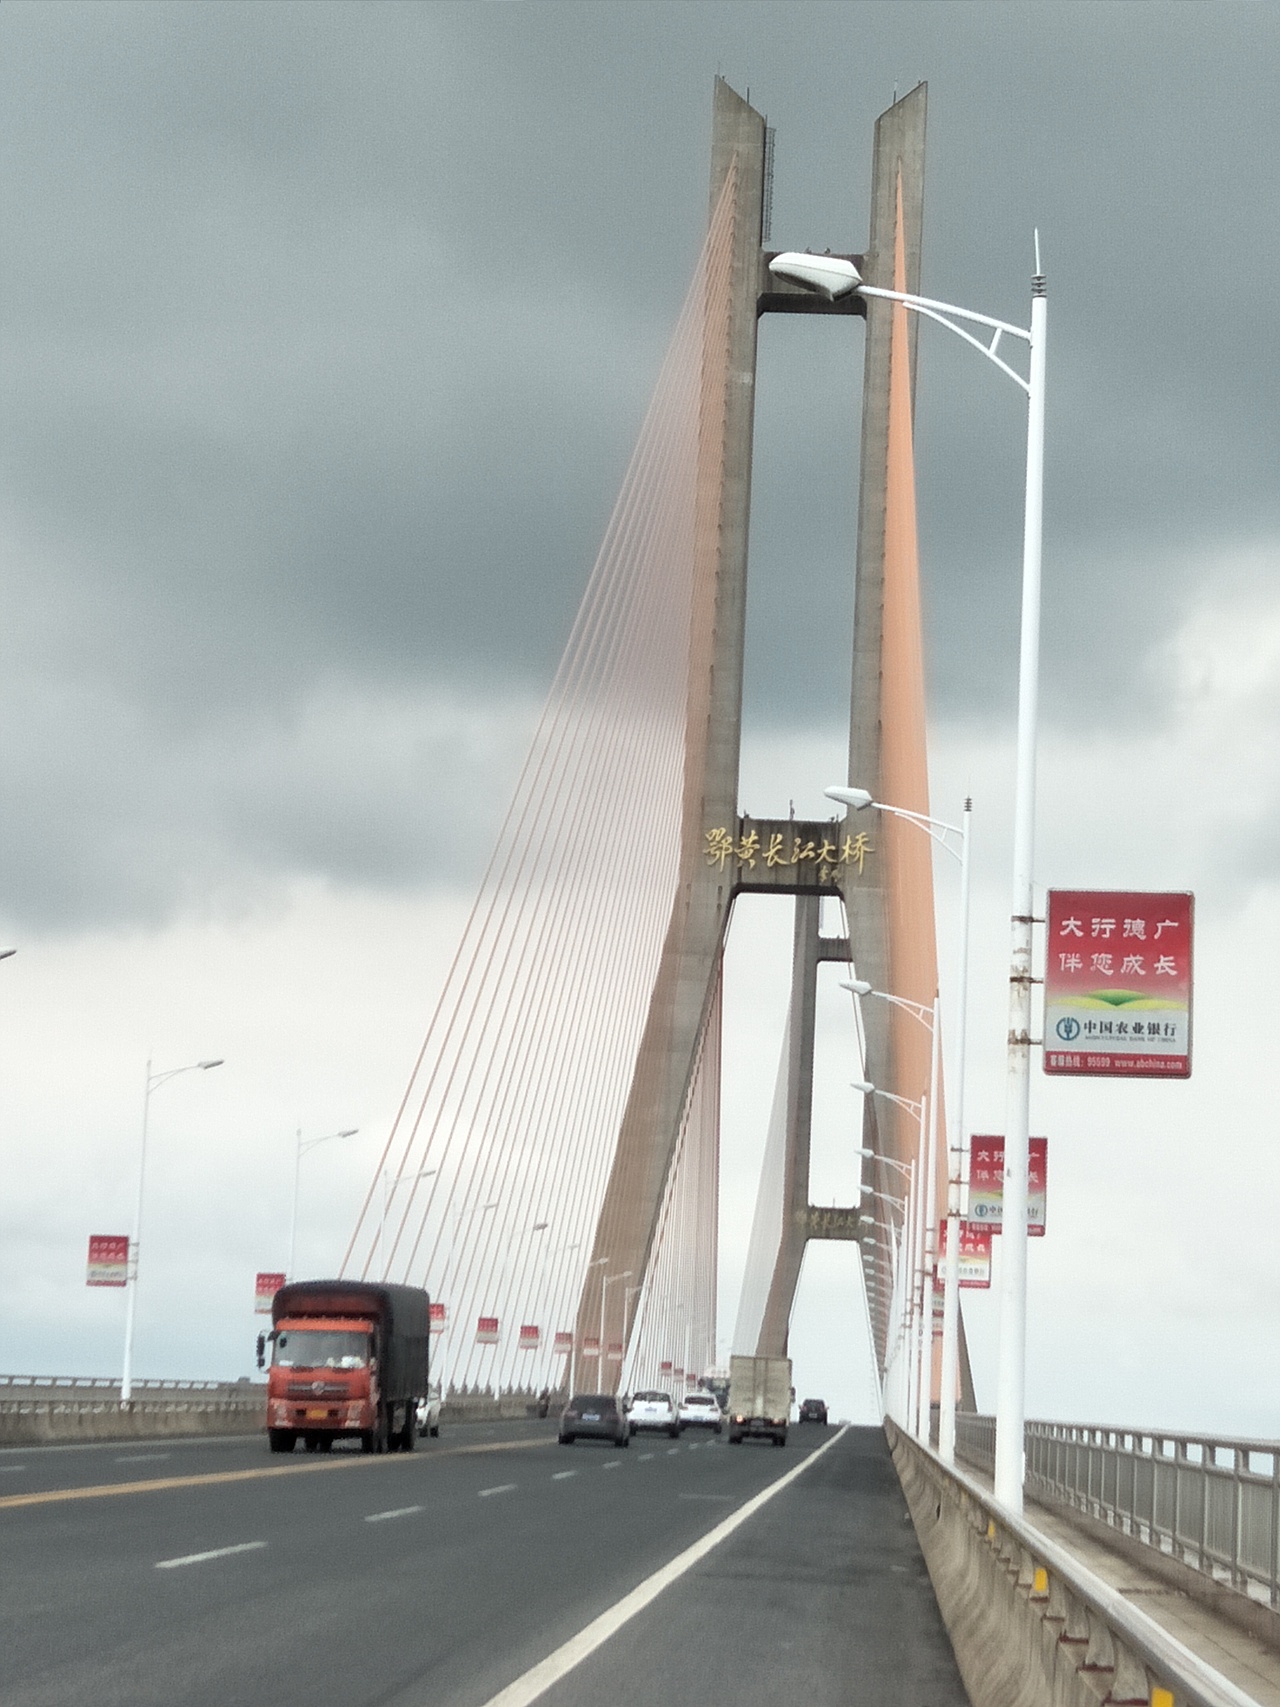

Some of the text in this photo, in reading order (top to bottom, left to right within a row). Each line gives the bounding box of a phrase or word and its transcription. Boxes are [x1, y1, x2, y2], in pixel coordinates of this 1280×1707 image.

[703, 827, 876, 877] 鄂黄长江大桥
[1059, 916, 1180, 941] 大行德广
[1058, 952, 1178, 977] 伴您成长
[1083, 1019, 1177, 1037] 中国农业银行
